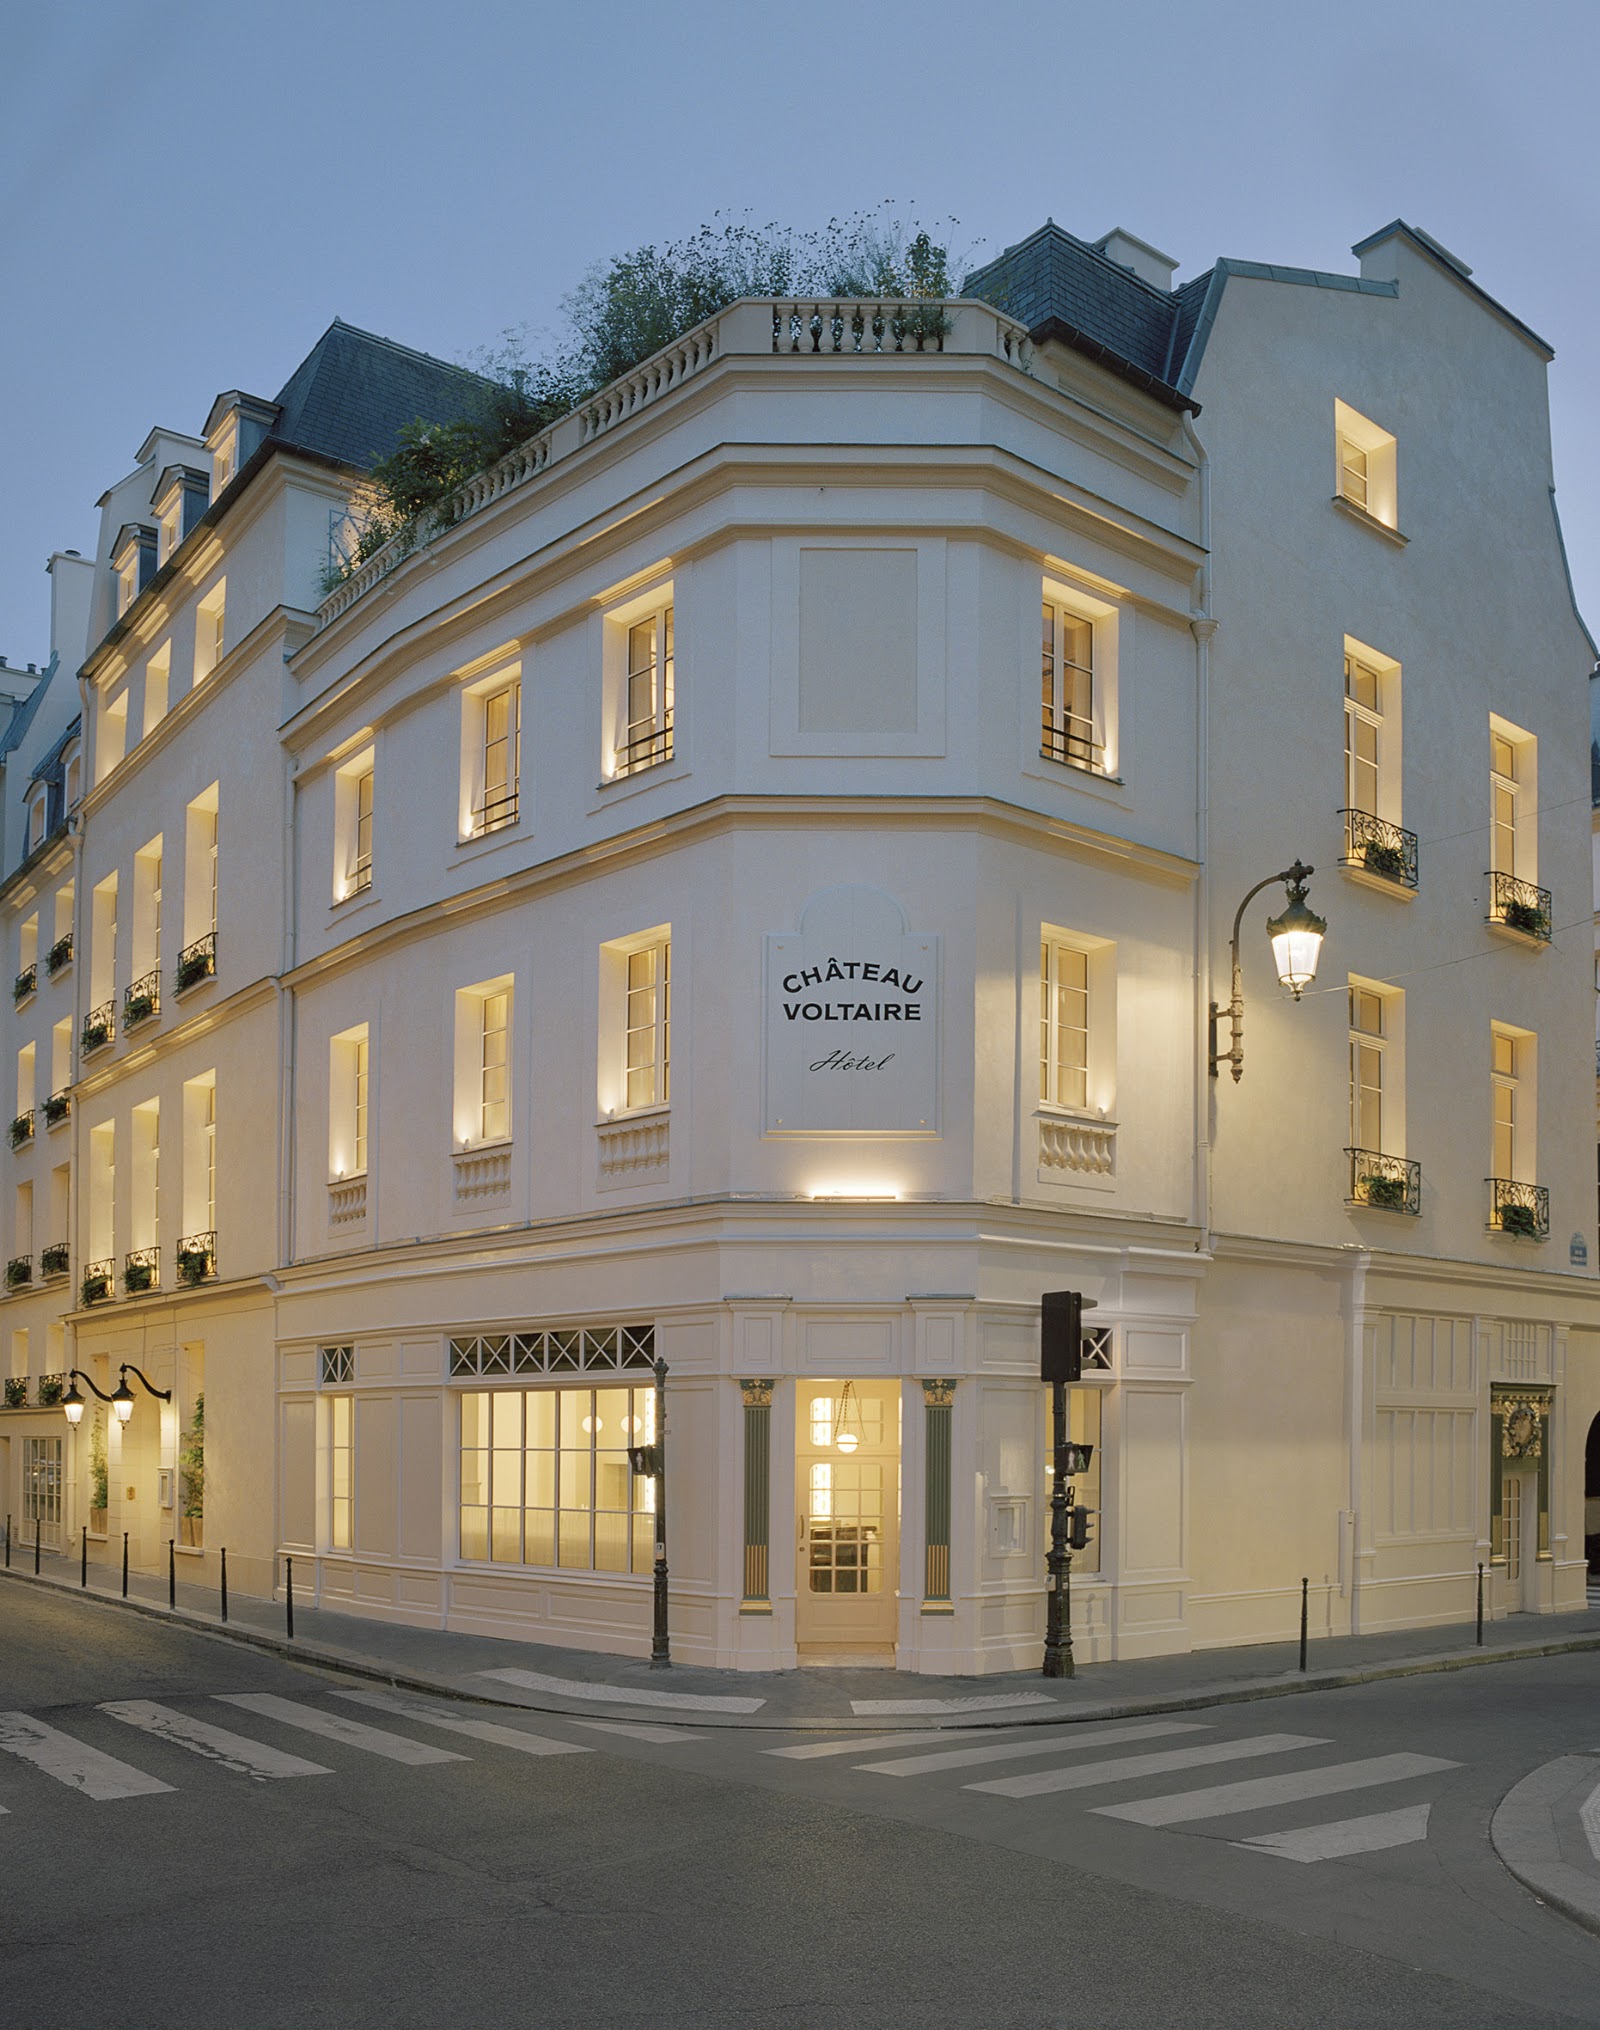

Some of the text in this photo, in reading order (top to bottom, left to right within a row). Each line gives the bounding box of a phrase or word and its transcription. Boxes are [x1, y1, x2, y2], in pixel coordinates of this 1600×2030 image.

[783, 957, 923, 994] CHÂTEAU
[783, 1003, 921, 1021] VOLTAIRE
[809, 1050, 895, 1072] Hôtel
